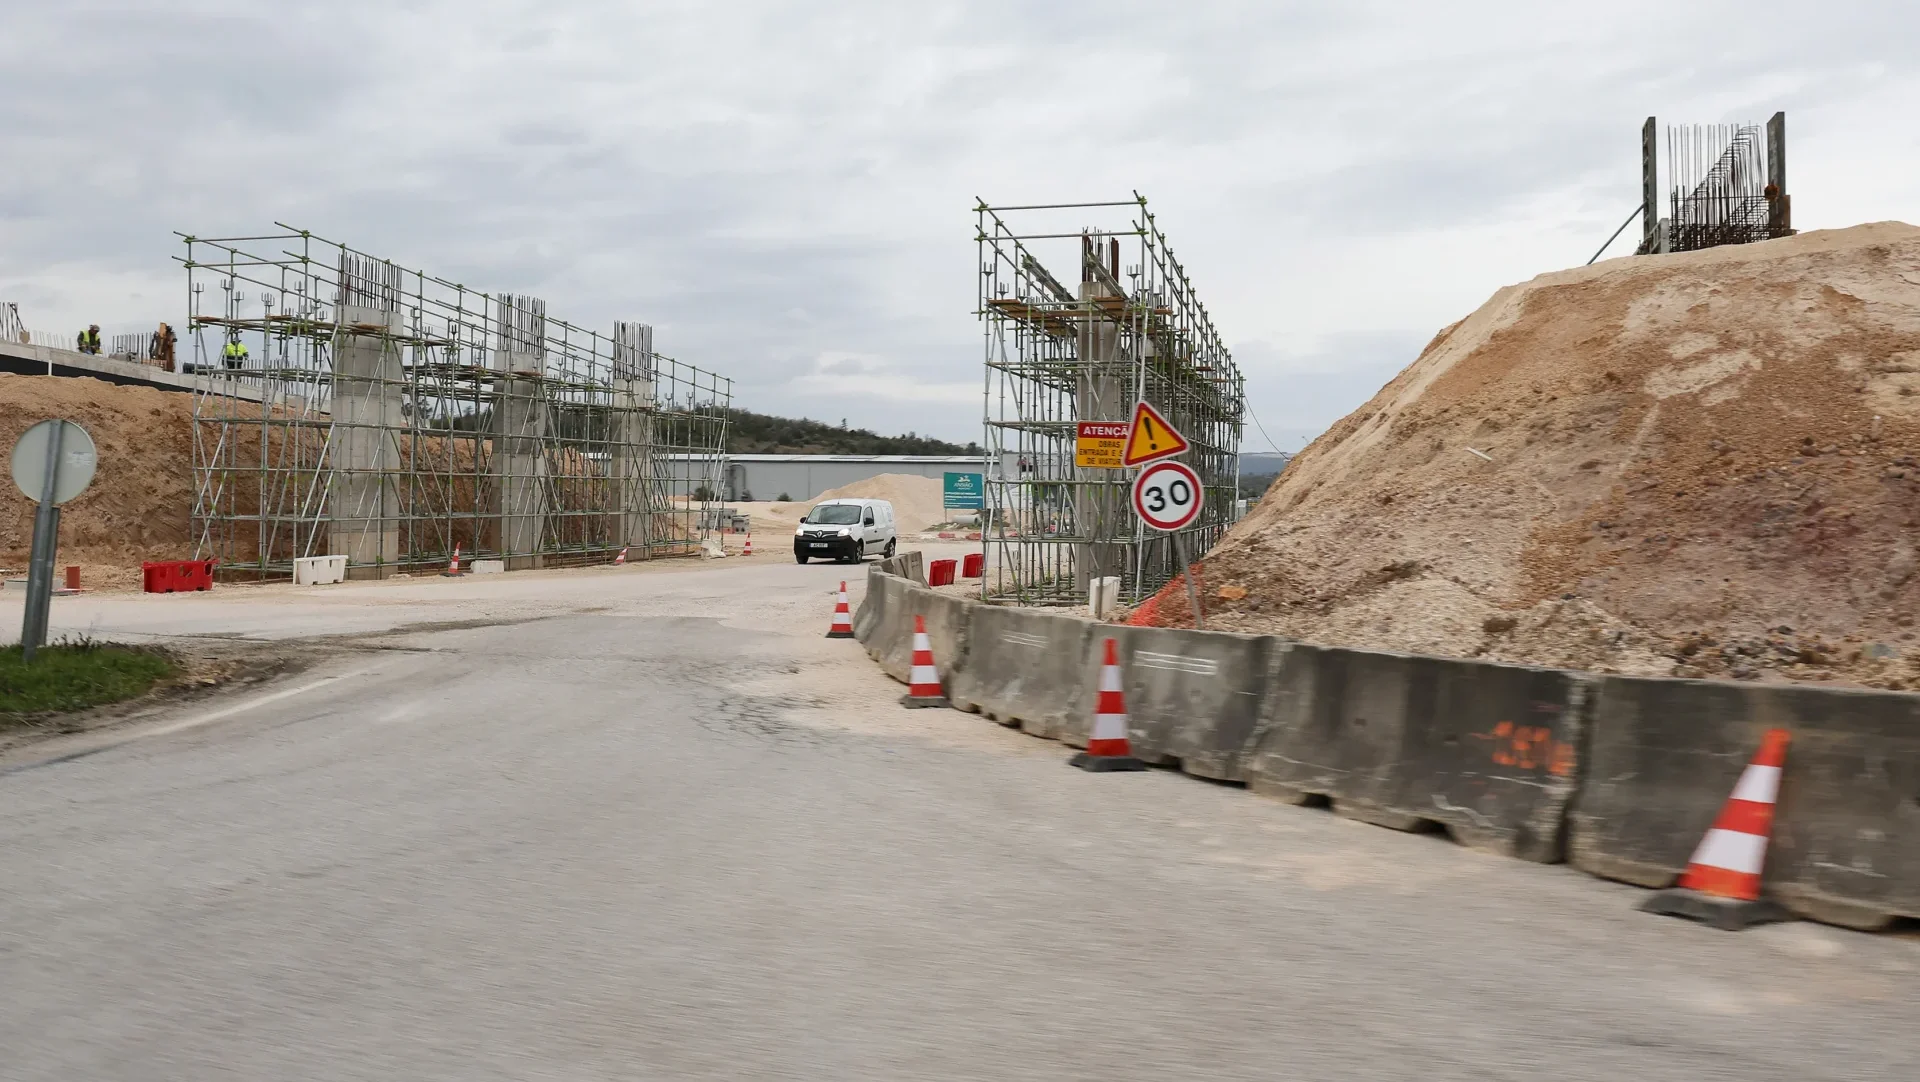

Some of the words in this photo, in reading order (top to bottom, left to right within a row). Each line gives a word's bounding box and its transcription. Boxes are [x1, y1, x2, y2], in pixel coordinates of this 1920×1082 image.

[1083, 425, 1128, 438] ATENÇÃ
[1098, 440, 1120, 448] OBRAS
[1079, 448, 1108, 456] ENTRADA
[1111, 449, 1116, 457] E
[1087, 457, 1096, 465] DE
[1145, 480, 1190, 512] 30
